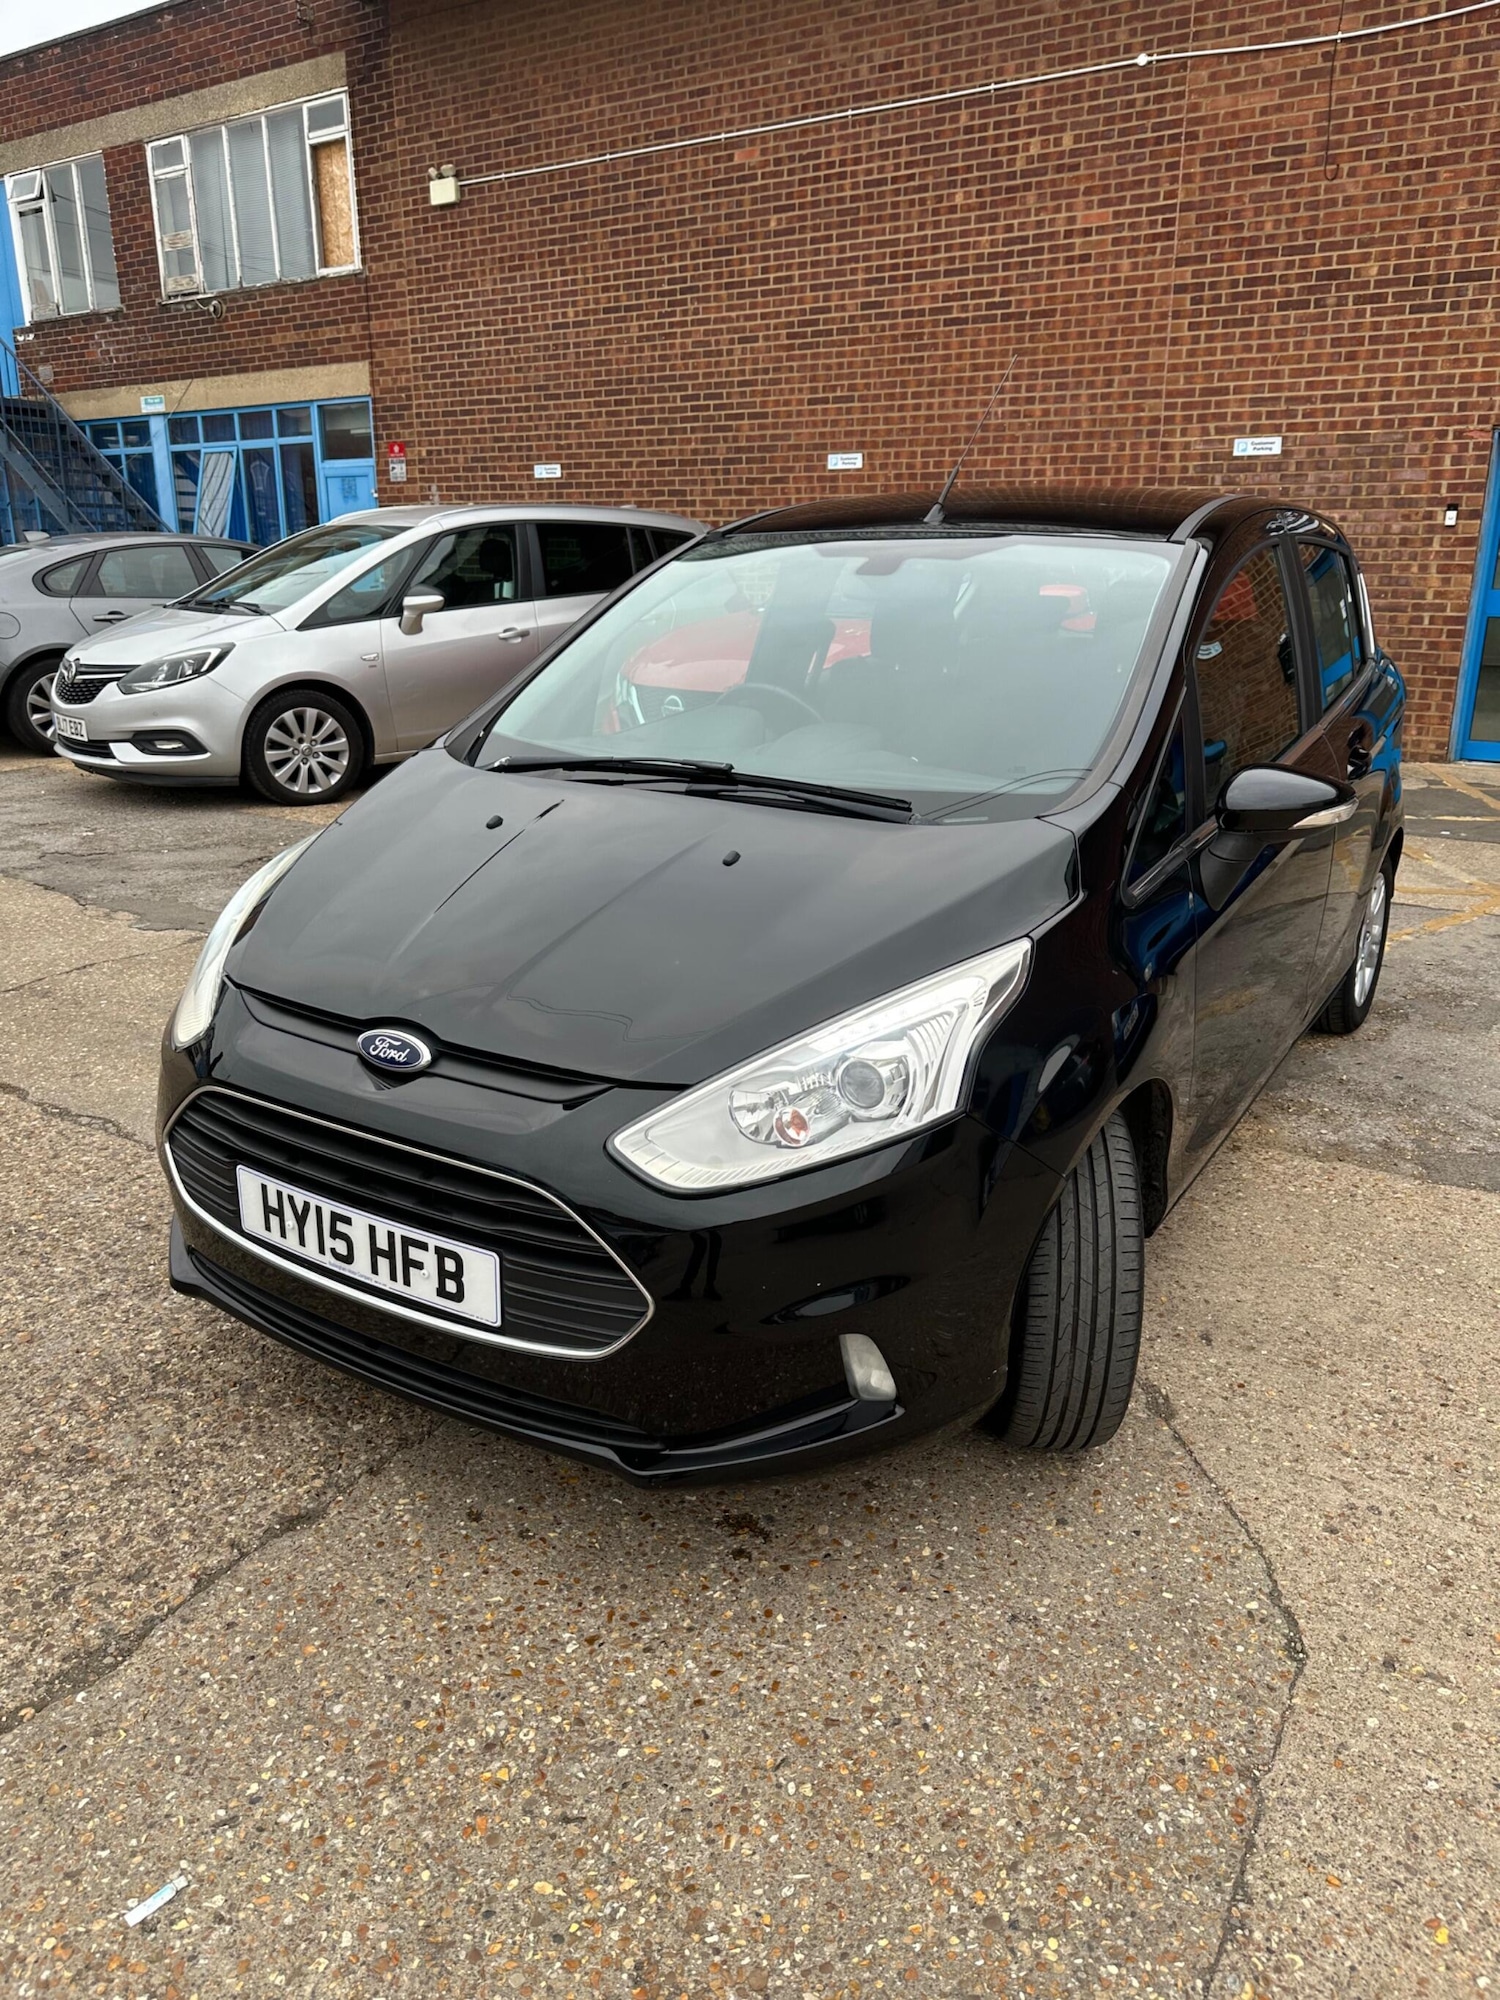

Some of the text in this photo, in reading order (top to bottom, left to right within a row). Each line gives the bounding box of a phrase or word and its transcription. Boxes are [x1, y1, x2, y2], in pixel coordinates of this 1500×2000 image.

[69, 720, 84, 737] EBZ
[369, 1036, 411, 1063] Ford
[261, 1183, 465, 1304] HY15 HFB
